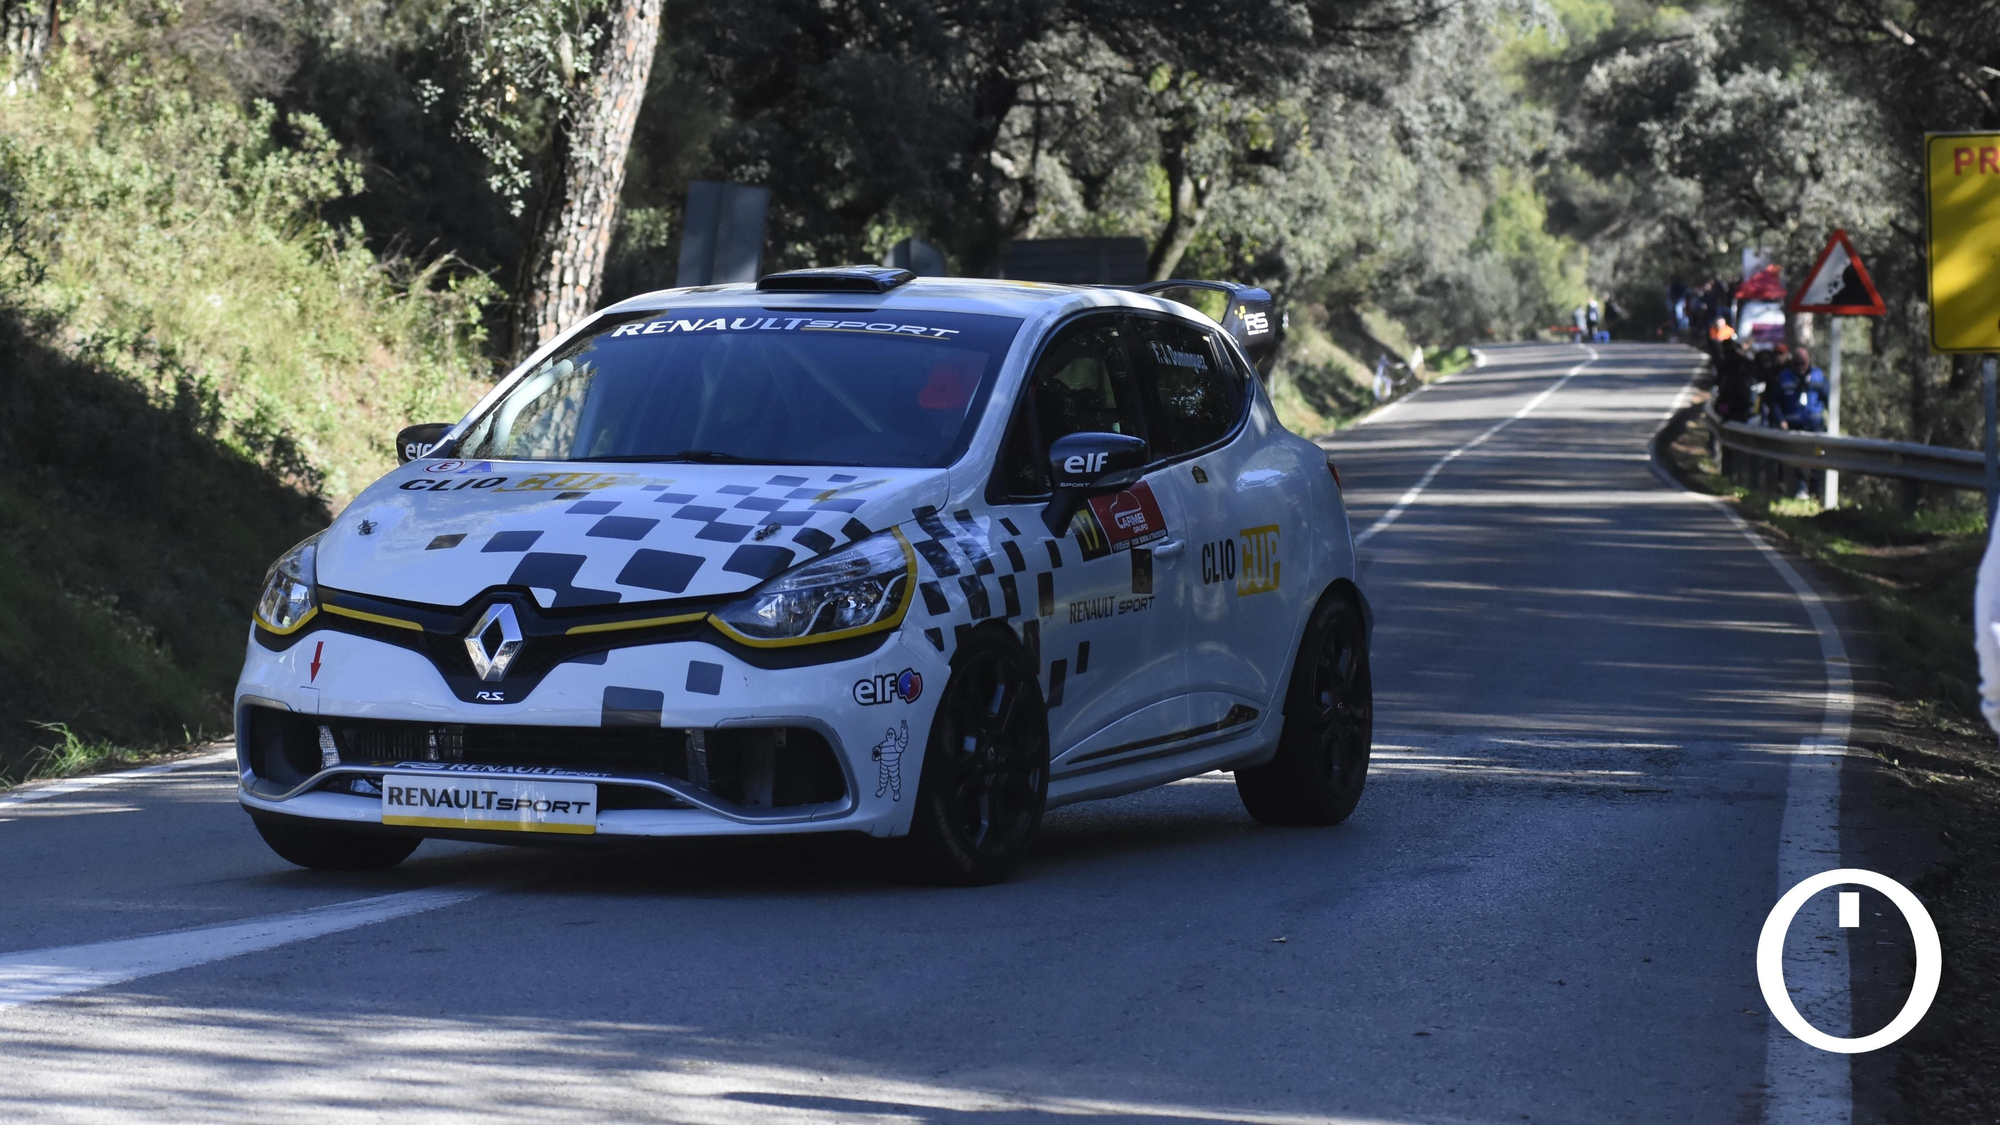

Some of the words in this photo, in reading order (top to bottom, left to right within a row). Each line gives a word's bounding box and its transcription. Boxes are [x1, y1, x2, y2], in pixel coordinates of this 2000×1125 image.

[1244, 312, 1269, 331] RS
[1063, 452, 1109, 474] elf
[398, 476, 509, 492] CLIO
[496, 473, 630, 493] CUP
[1132, 523, 1149, 534] GRUPO
[1201, 538, 1236, 585] CLIO
[1240, 528, 1281, 593] CUP
[1069, 595, 1116, 624] RENAULT
[1118, 595, 1156, 616] SPORT
[853, 672, 898, 706] elf
